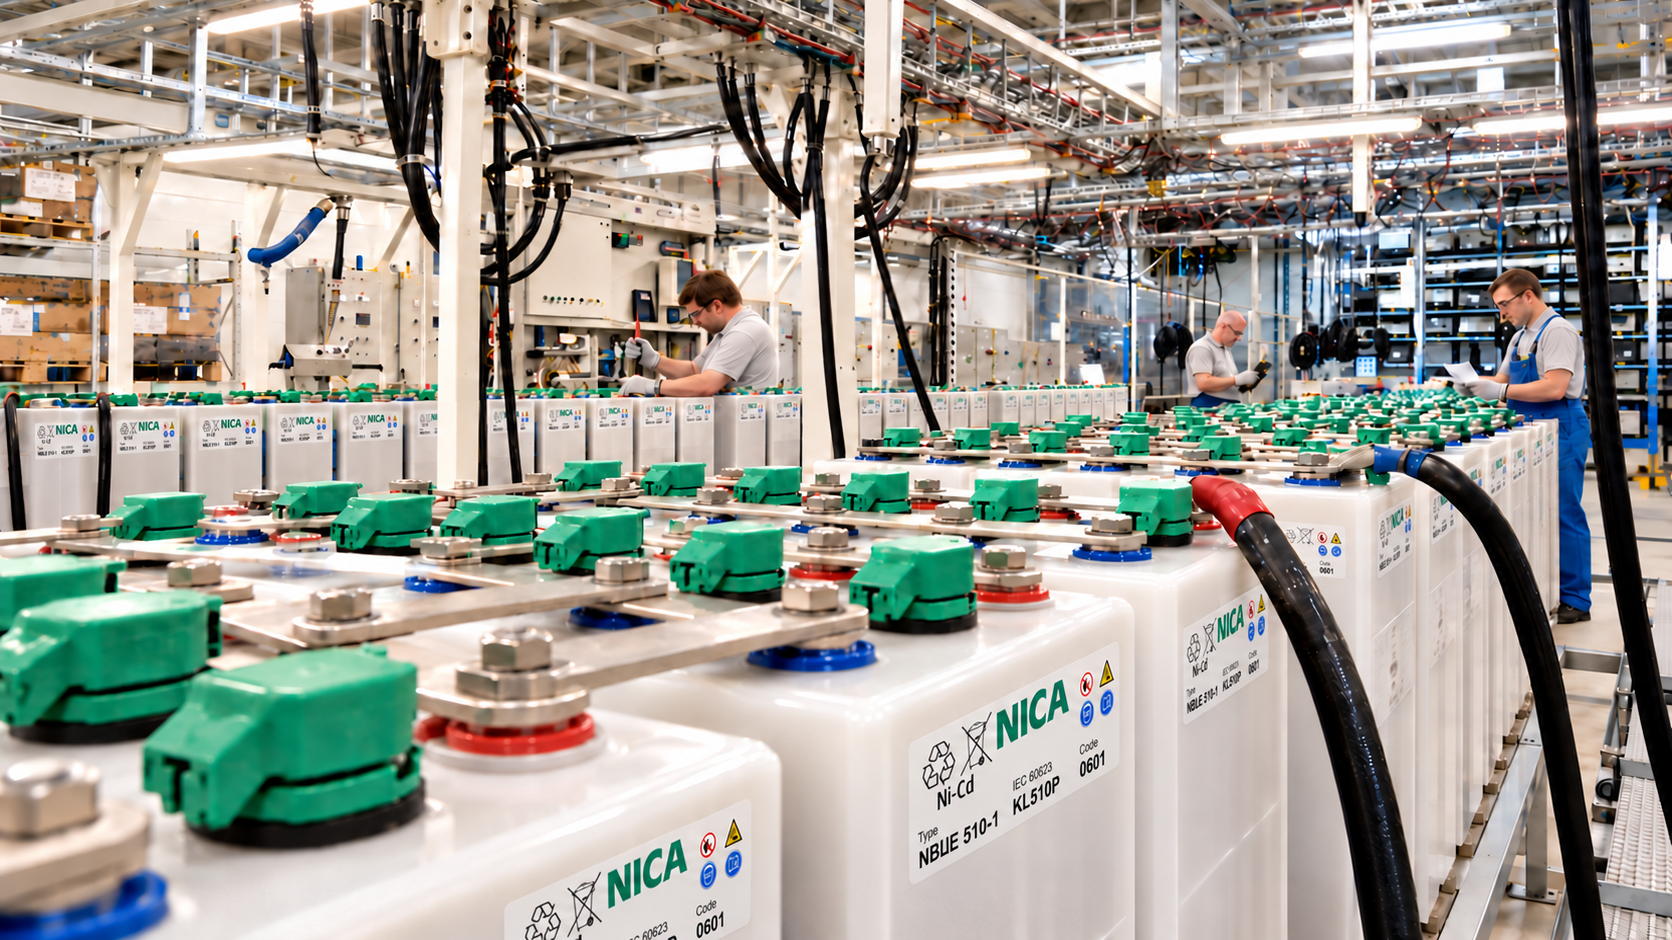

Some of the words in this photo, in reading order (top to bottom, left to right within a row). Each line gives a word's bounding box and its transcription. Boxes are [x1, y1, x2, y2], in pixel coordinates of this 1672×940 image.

[55, 424, 78, 435] NICA
[138, 421, 160, 432] NICA
[220, 418, 242, 429] NICA
[296, 416, 315, 425] NICA
[367, 414, 386, 424] NICA
[1217, 604, 1244, 643] NICA
[996, 679, 1070, 750] NICA
[1079, 738, 1099, 755] Code
[1012, 775, 1027, 791] IEC
[1028, 761, 1053, 783] 60623
[1079, 750, 1106, 778] 0601
[937, 774, 975, 810] Ni-Cd
[1013, 775, 1060, 816] KL510P
[918, 826, 939, 844] Type
[963, 810, 999, 844] 510-1
[607, 839, 688, 909] NICA
[696, 900, 717, 917] Code
[696, 911, 725, 939] 0601
